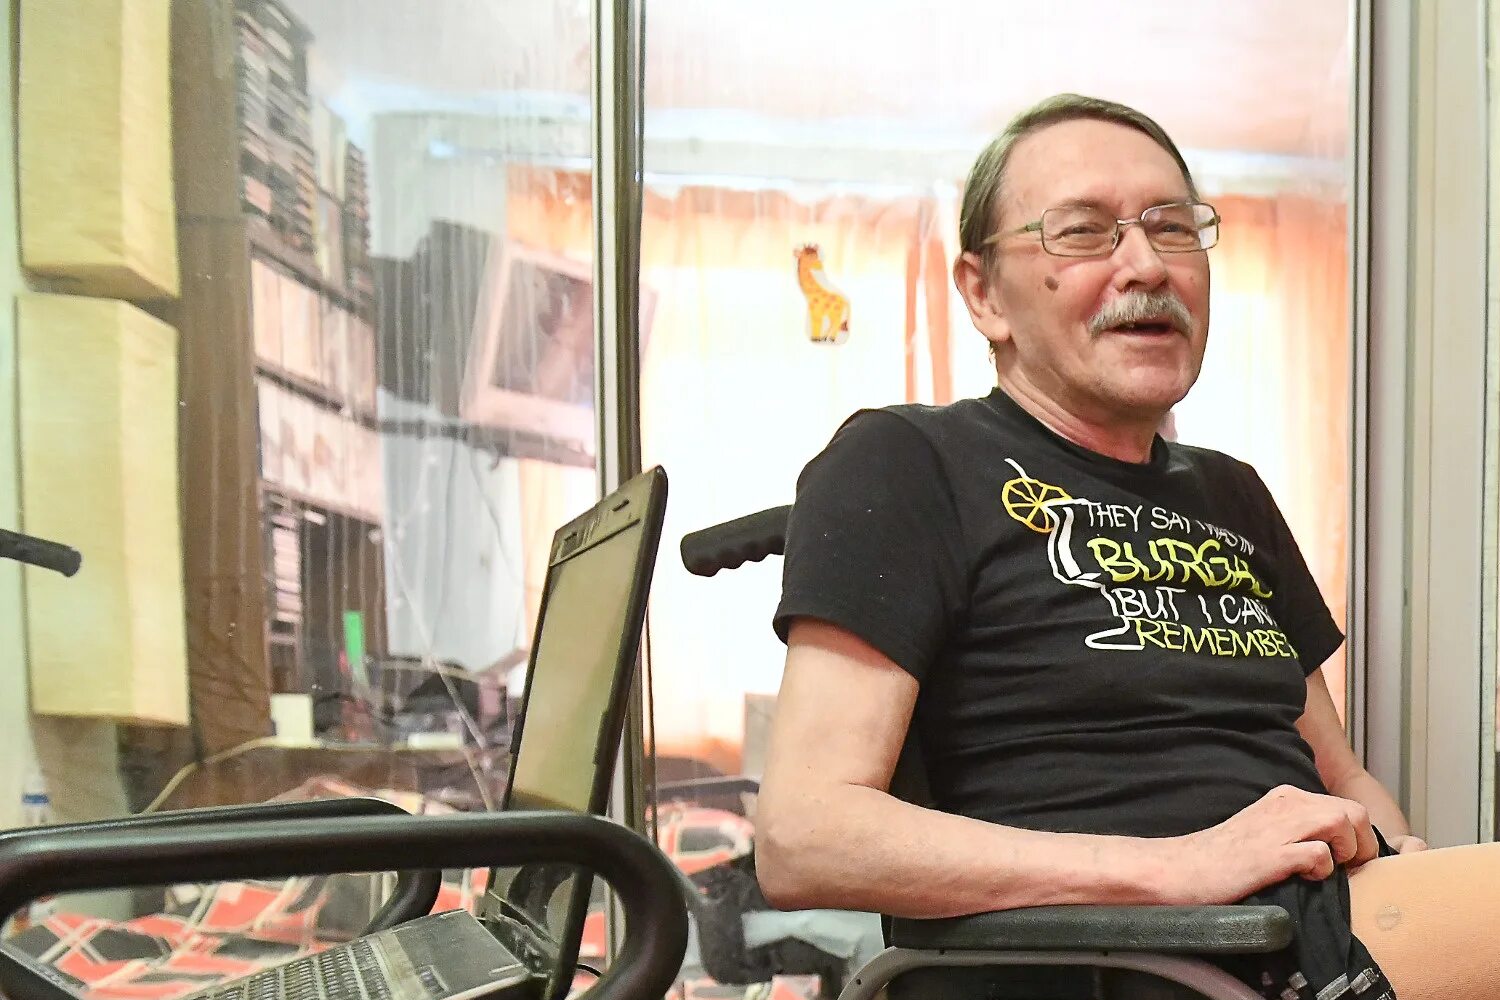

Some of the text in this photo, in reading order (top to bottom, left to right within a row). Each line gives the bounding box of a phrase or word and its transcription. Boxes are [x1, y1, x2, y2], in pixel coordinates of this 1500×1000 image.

[1086, 502, 1143, 532] THEY
[1111, 586, 1187, 621] BUT
[1197, 594, 1213, 624] I
